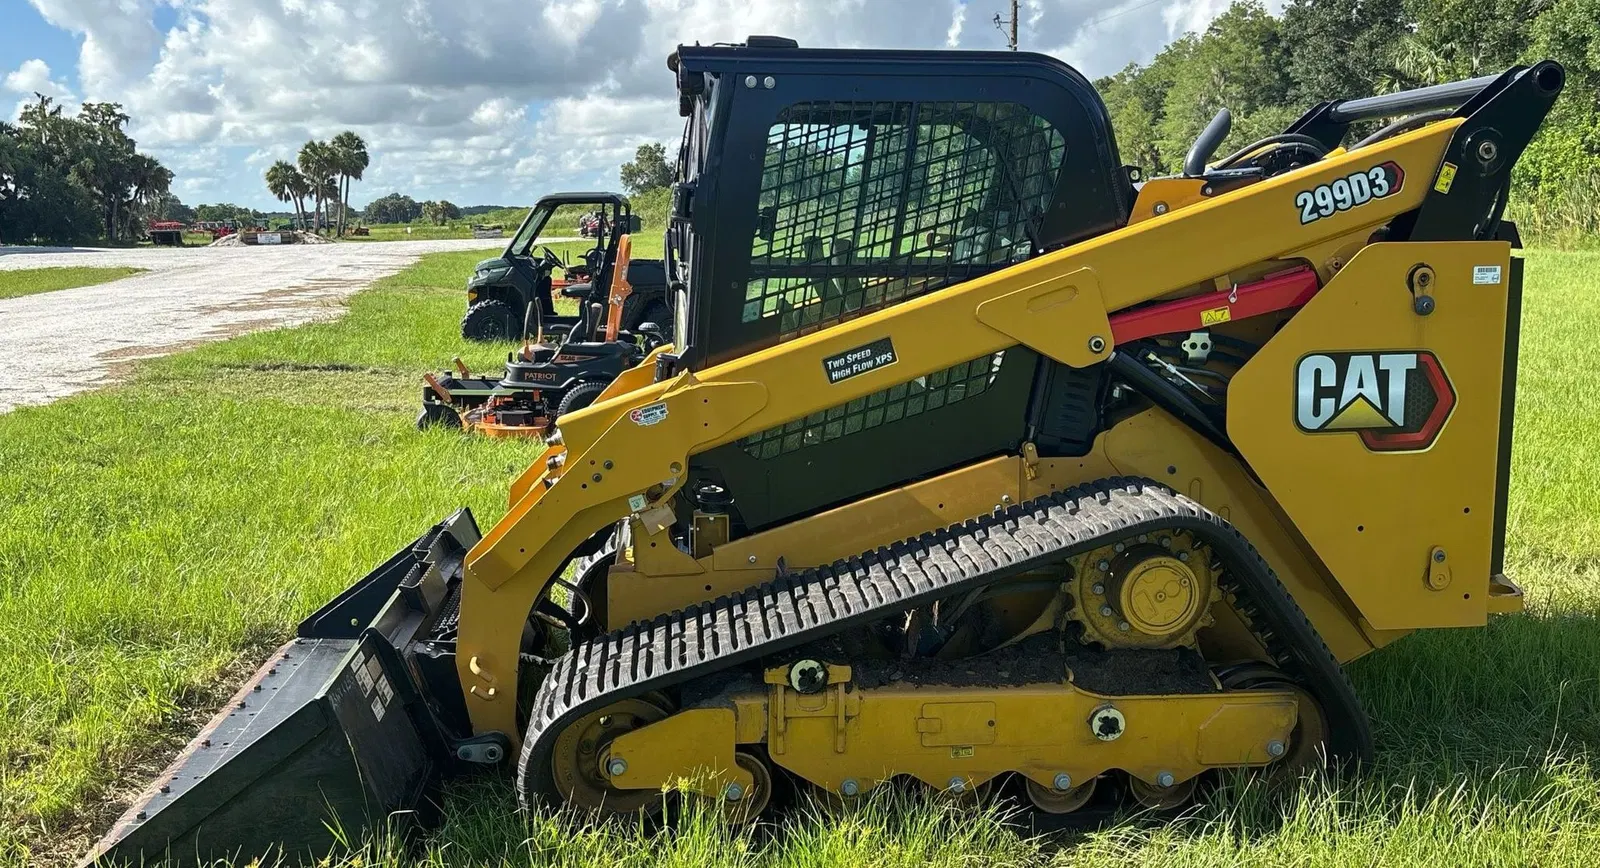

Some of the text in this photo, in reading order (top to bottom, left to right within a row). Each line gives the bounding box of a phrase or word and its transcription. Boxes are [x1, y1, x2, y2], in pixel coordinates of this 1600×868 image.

[1296, 166, 1389, 223] 299D3
[827, 348, 871, 370] TWO SPEED
[831, 352, 893, 380] HIGH FLOW XPS
[524, 372, 556, 381] PATRIOT
[1298, 354, 1417, 430] CAT
